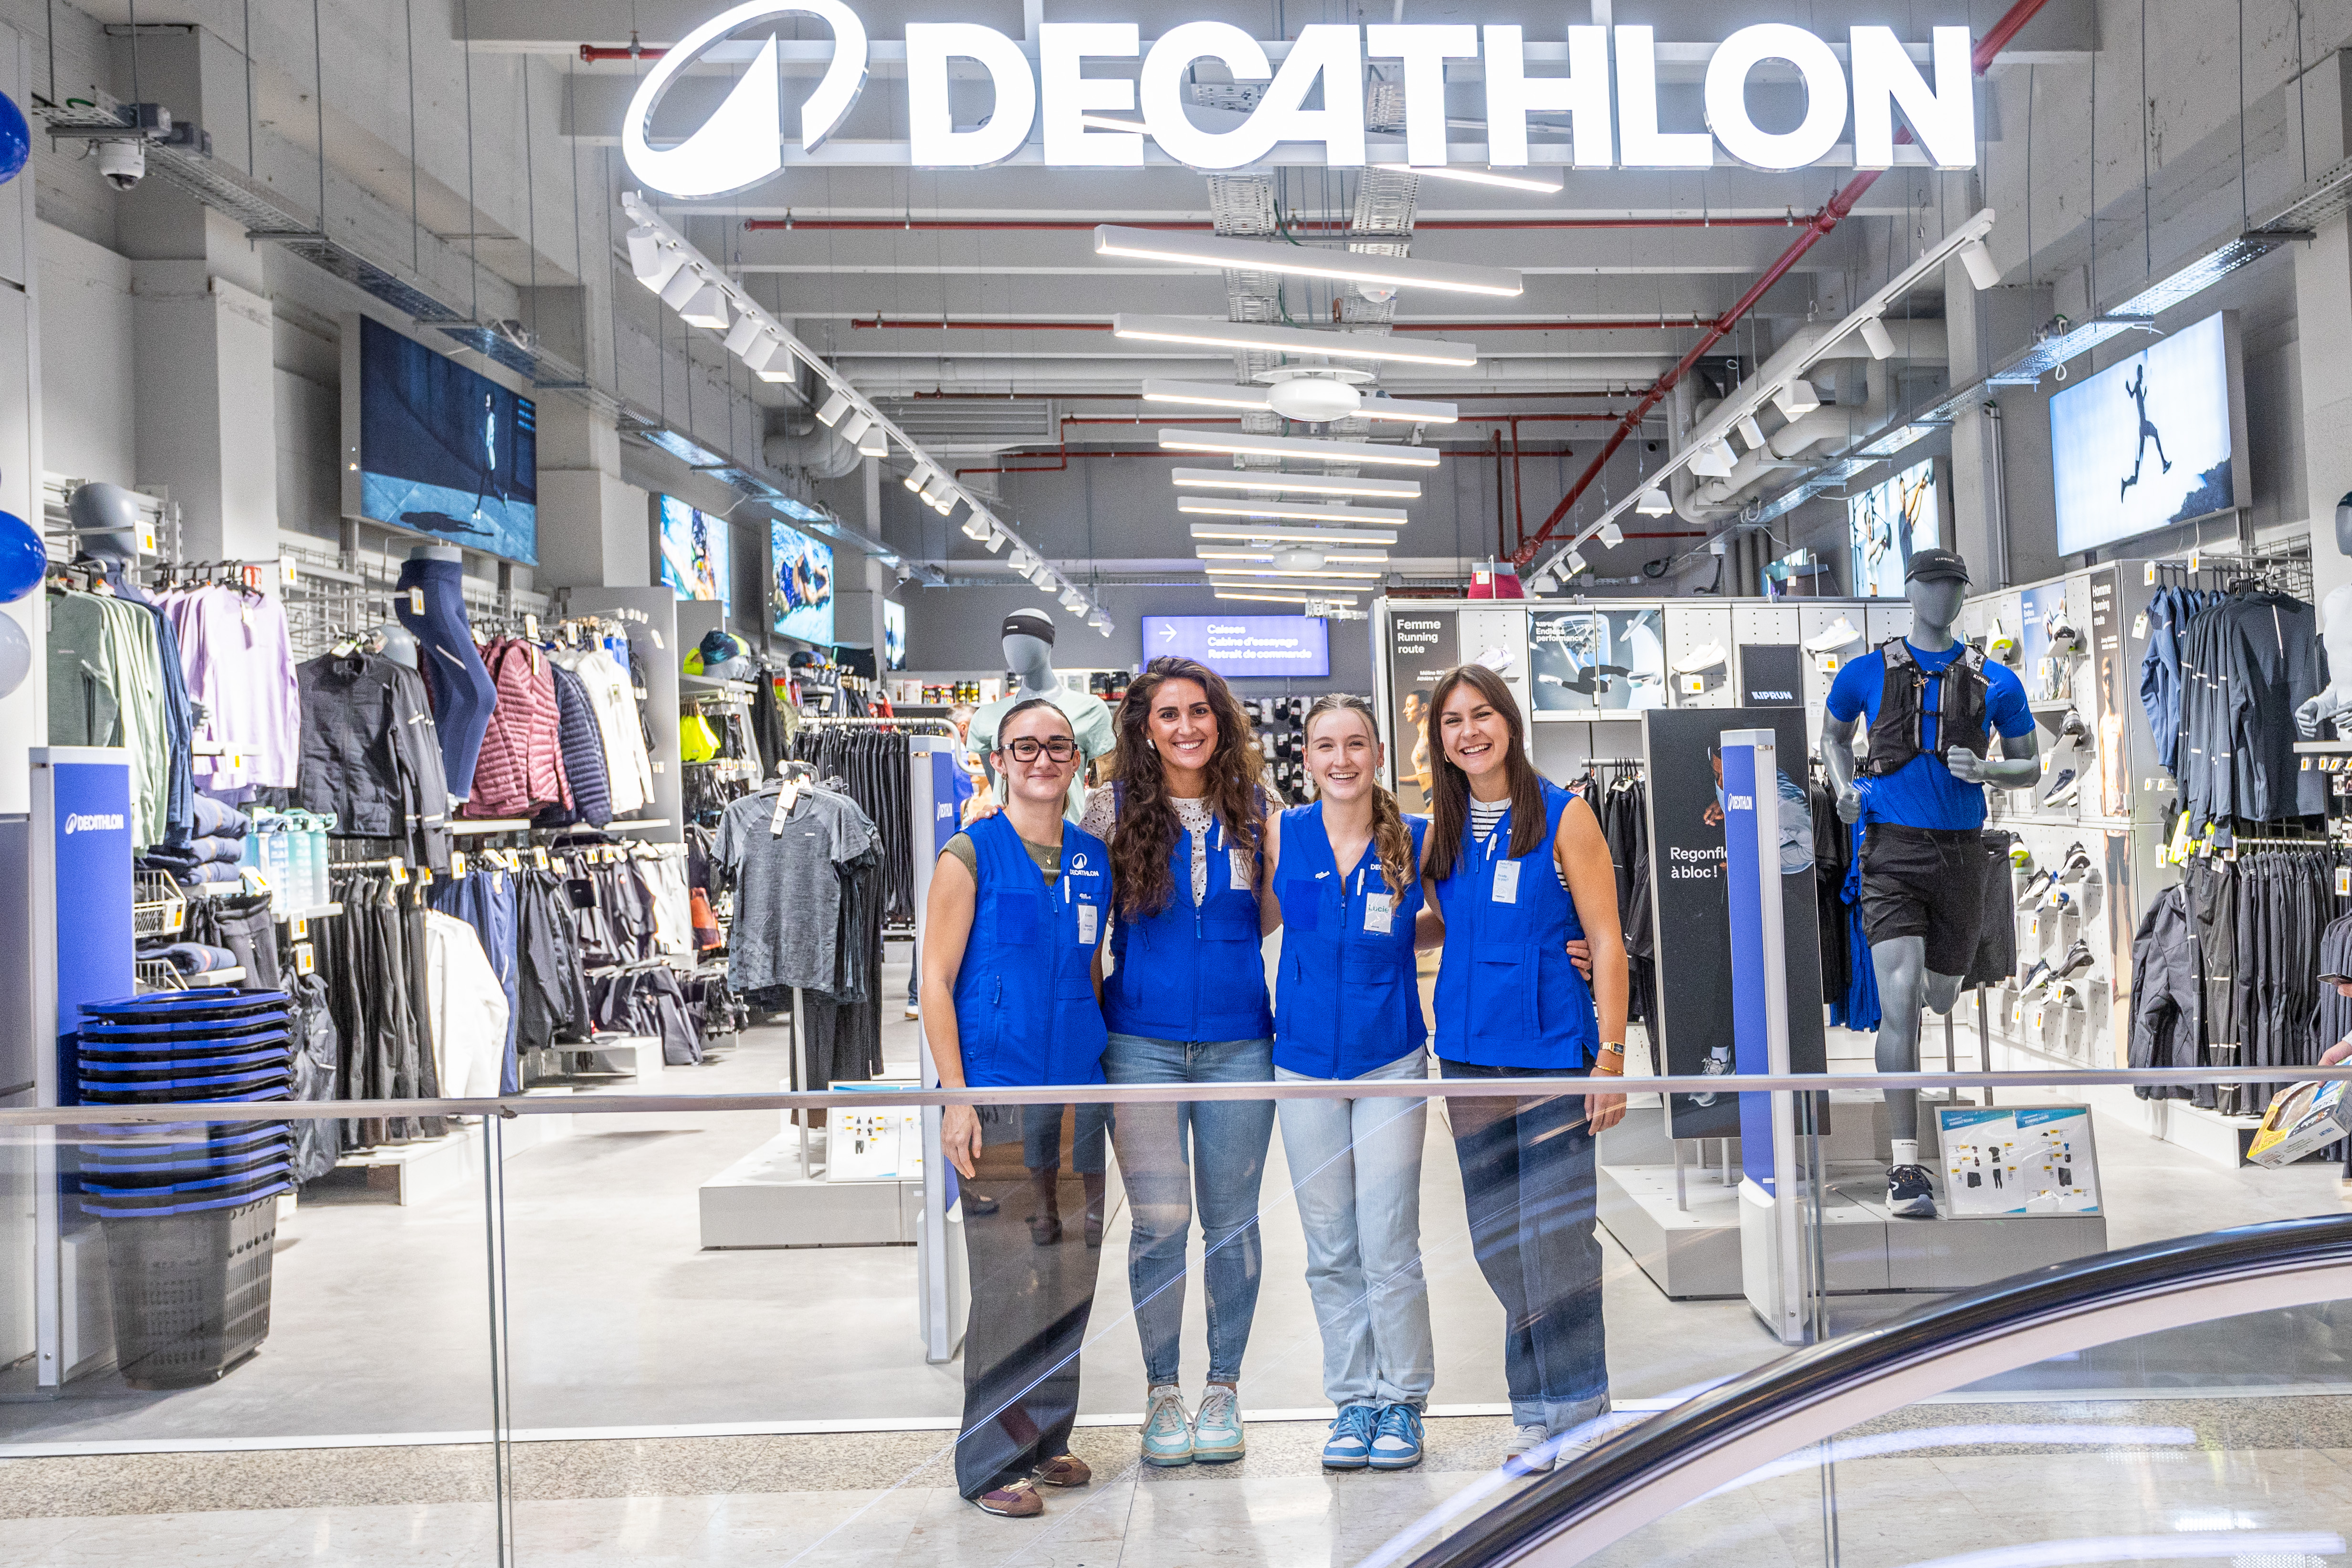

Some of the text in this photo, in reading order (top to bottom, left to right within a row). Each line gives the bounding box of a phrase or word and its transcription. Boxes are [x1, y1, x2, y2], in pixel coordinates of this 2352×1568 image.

[906, 21, 1977, 169] DECATHLON
[2092, 584, 2111, 598] Homme
[2093, 599, 2110, 612] Running
[1396, 619, 1441, 630] Femme
[2094, 615, 2105, 626] route
[1207, 624, 1246, 634] Caisses
[1208, 637, 1298, 648] Cabine d'essayage
[1397, 632, 1438, 643] Running
[1208, 649, 1312, 659] Retrait de commande
[1398, 645, 1425, 653] route
[1752, 691, 1793, 700] KIPRUN
[1732, 796, 1753, 810] DECATHLON
[77, 814, 124, 831] DECATHLON
[1671, 866, 1680, 878] à
[1681, 865, 1712, 878] bloc
[1368, 905, 1389, 913] Lucie
[2319, 1127, 2335, 1137] ANTIBES
